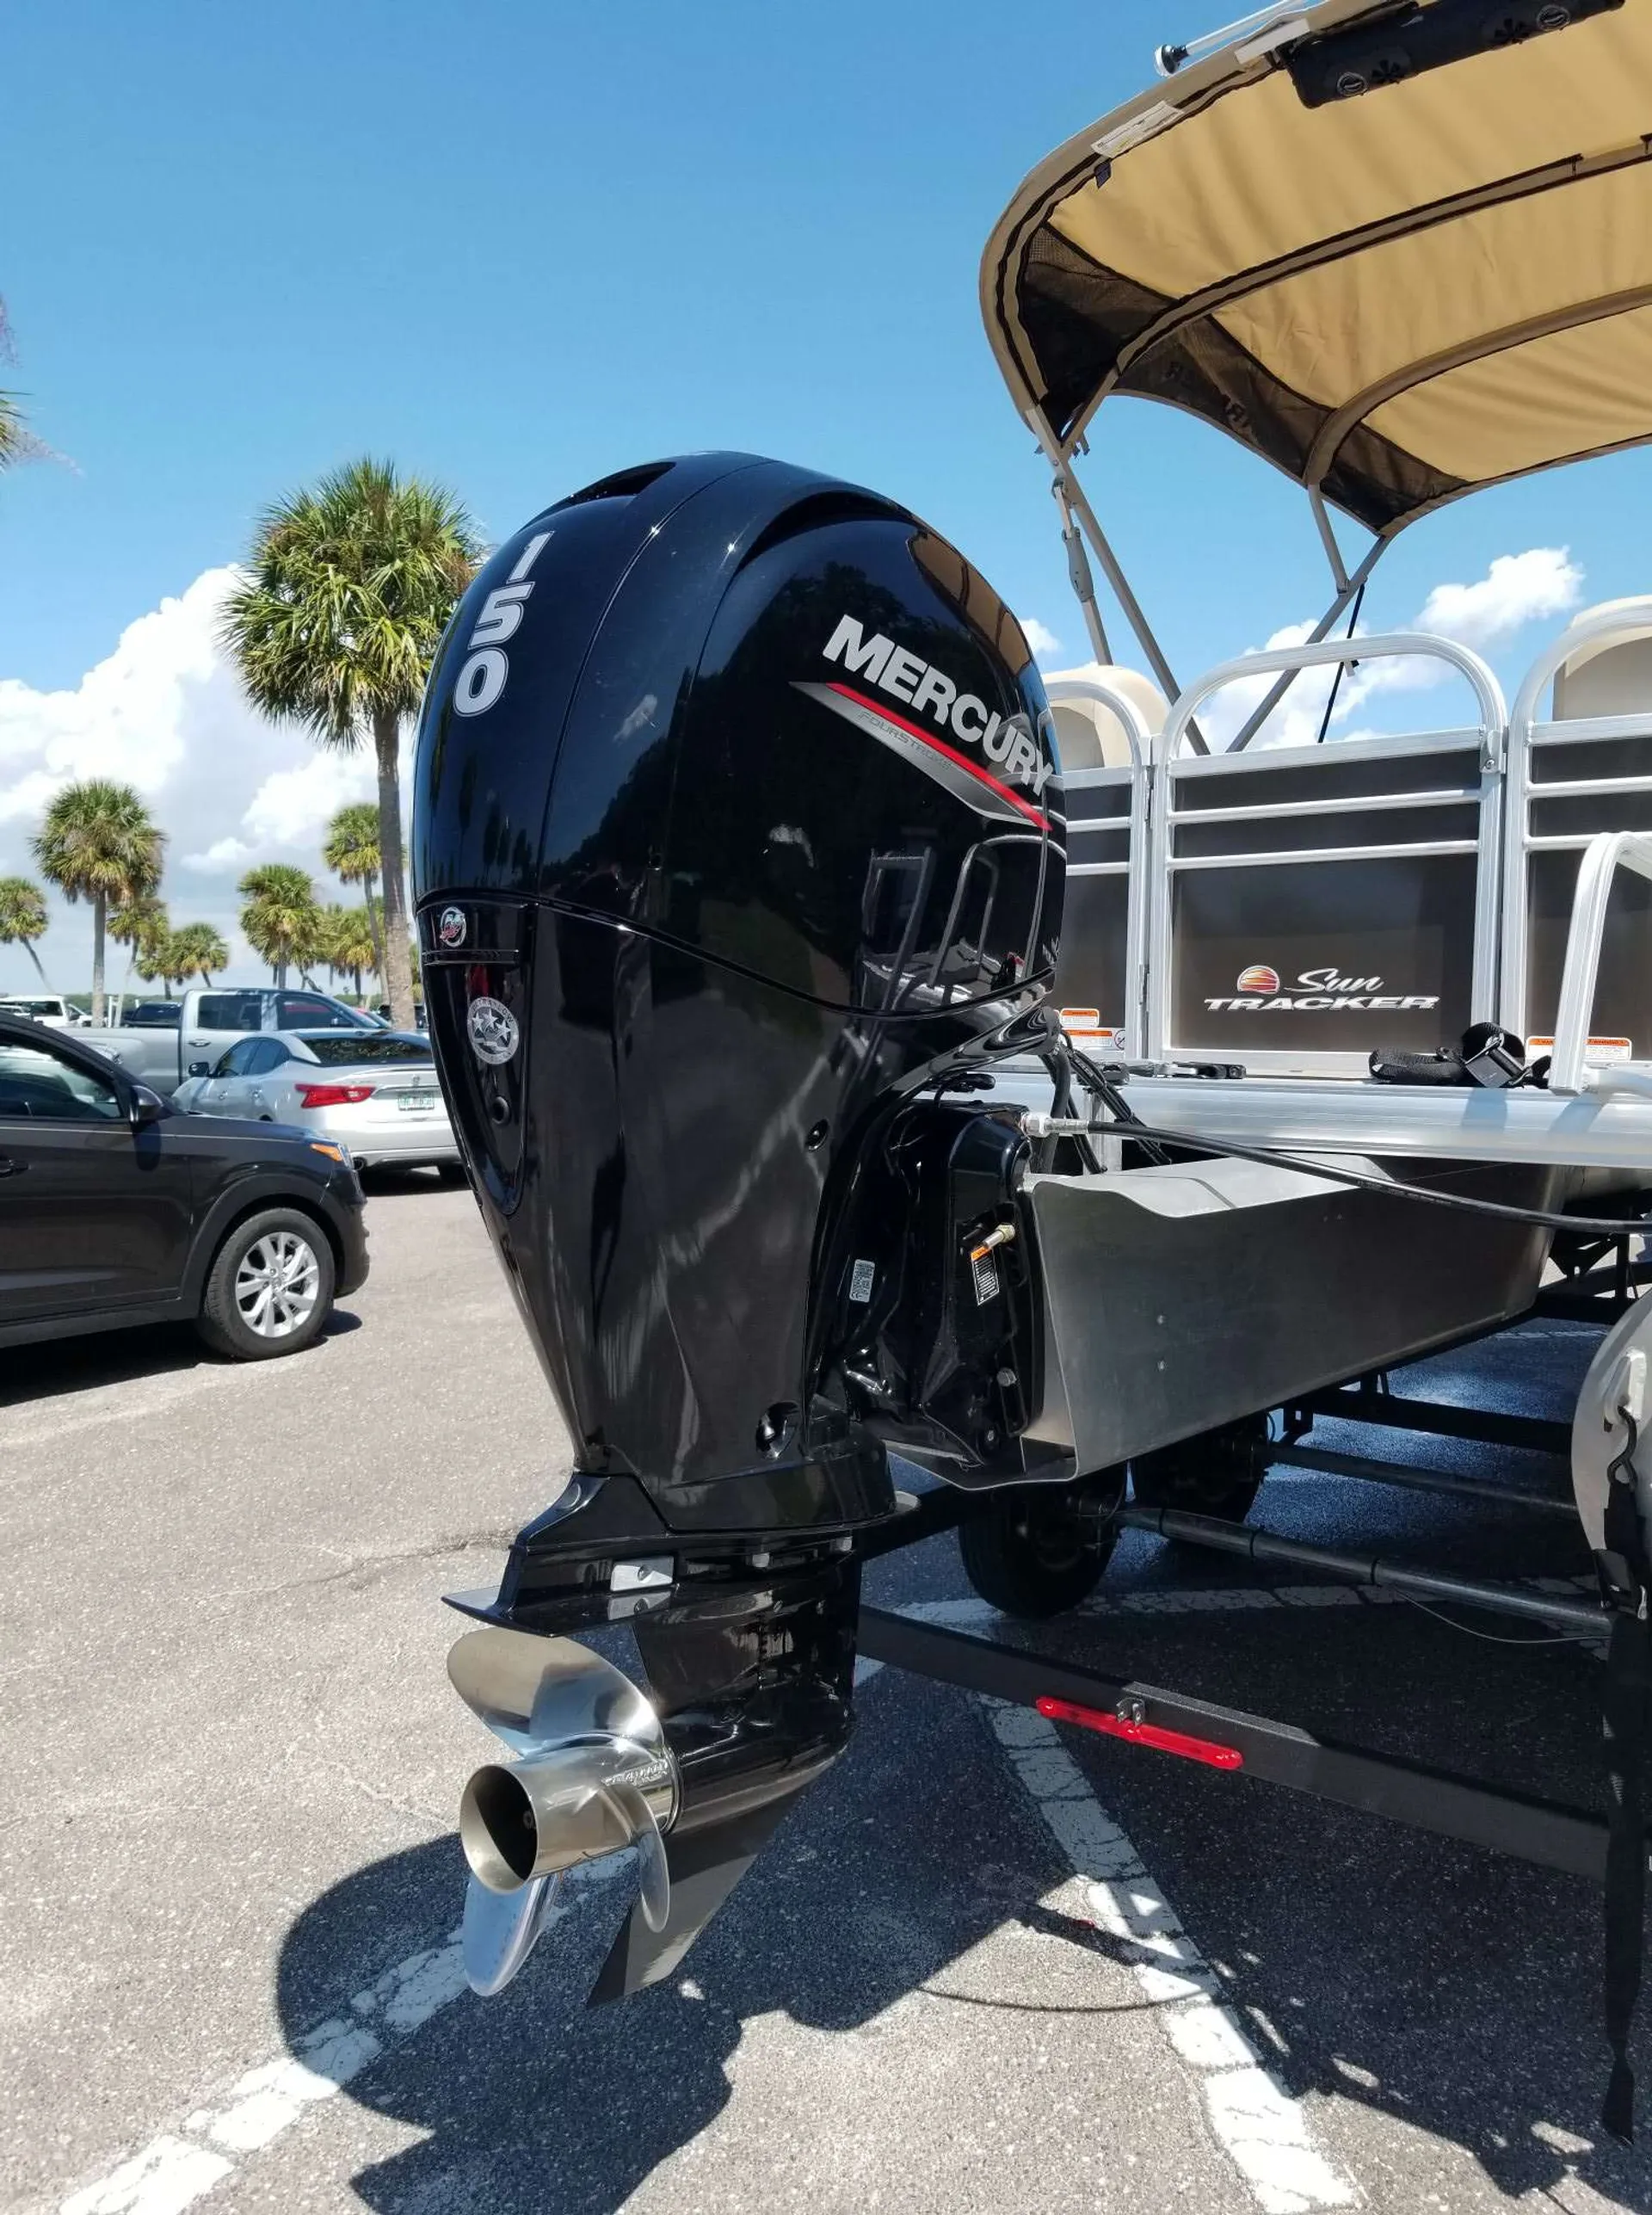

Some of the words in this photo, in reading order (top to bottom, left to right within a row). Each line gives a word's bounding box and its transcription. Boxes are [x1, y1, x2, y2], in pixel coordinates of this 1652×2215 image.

[453, 531, 555, 717] 150
[823, 614, 1053, 796] MERCURY
[1204, 996, 1440, 1011] TRACKER
[1284, 968, 1384, 992] Sun
